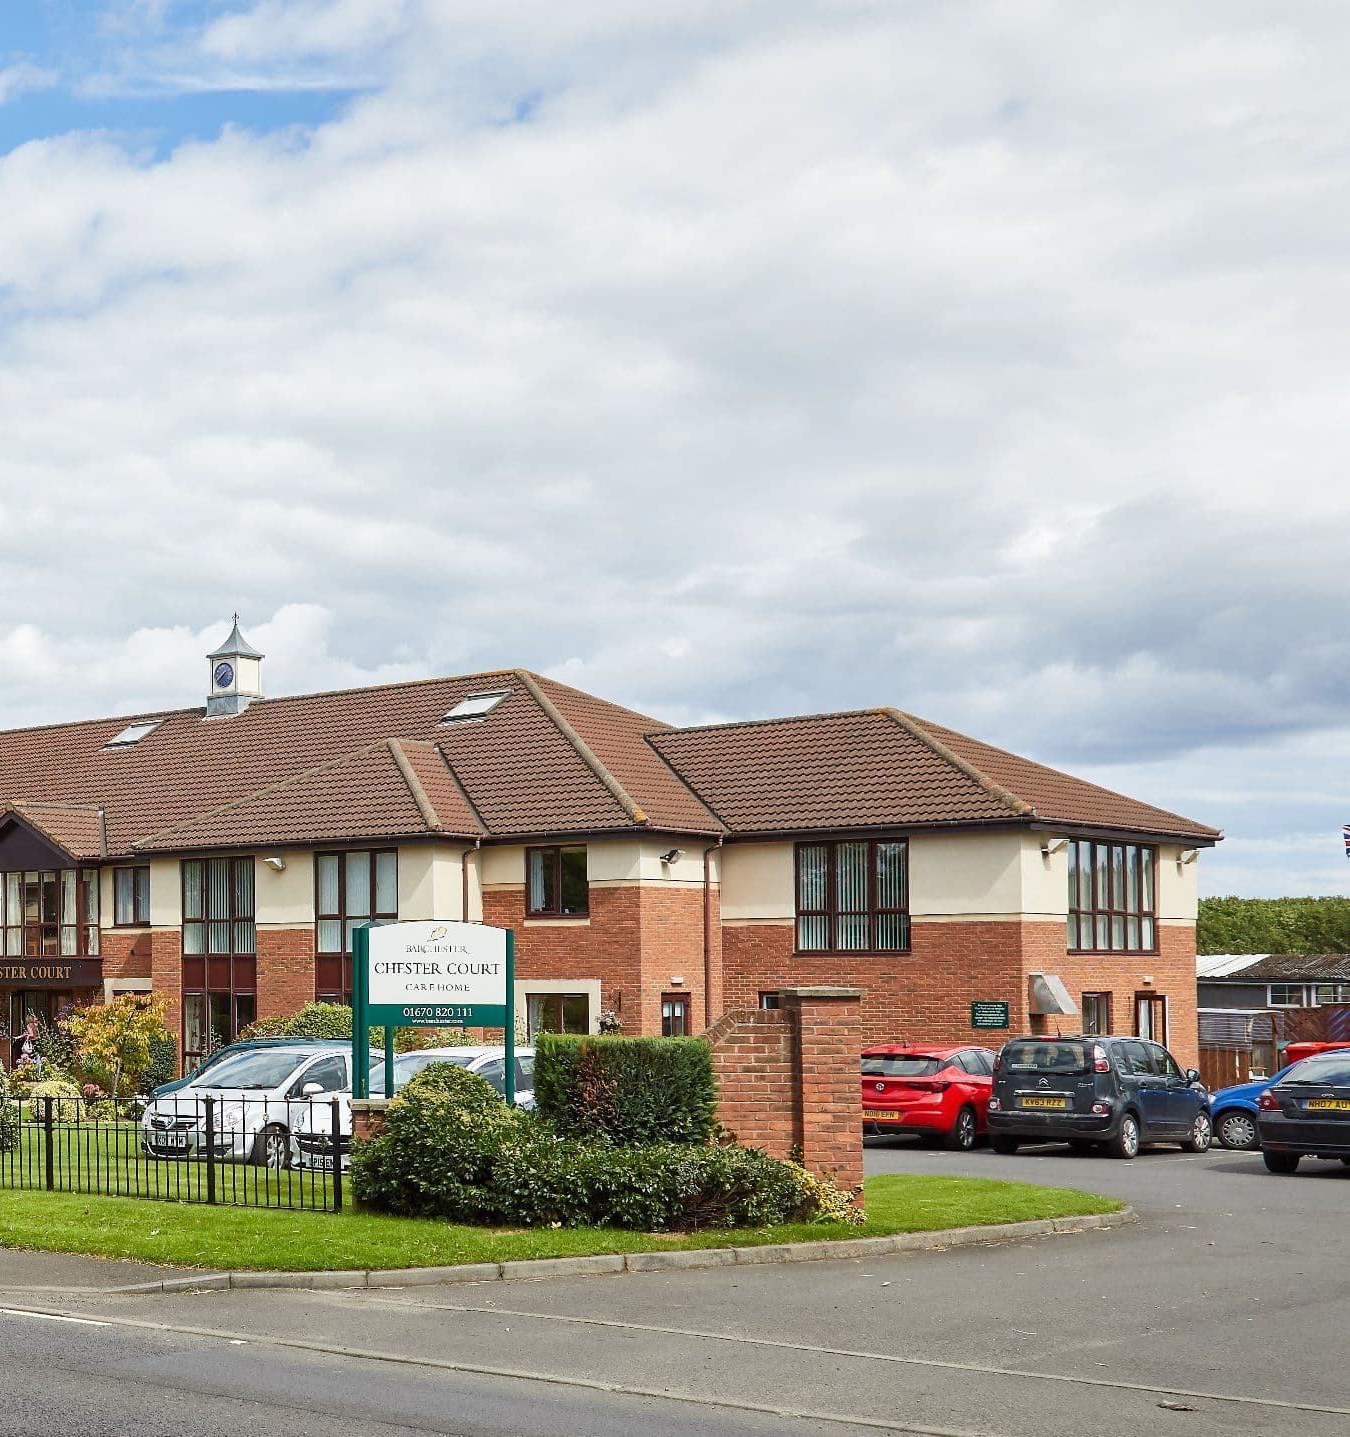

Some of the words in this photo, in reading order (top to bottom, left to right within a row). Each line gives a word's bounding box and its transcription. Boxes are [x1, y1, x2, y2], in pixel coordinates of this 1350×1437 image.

[30, 966, 72, 979] COURT
[374, 962, 443, 975] CHESTER
[447, 962, 501, 975] COURT
[405, 983, 434, 992] CARE
[437, 983, 471, 992] HOME
[403, 1007, 433, 1017] 01670
[435, 1007, 454, 1017] 820
[456, 1007, 473, 1017] 111
